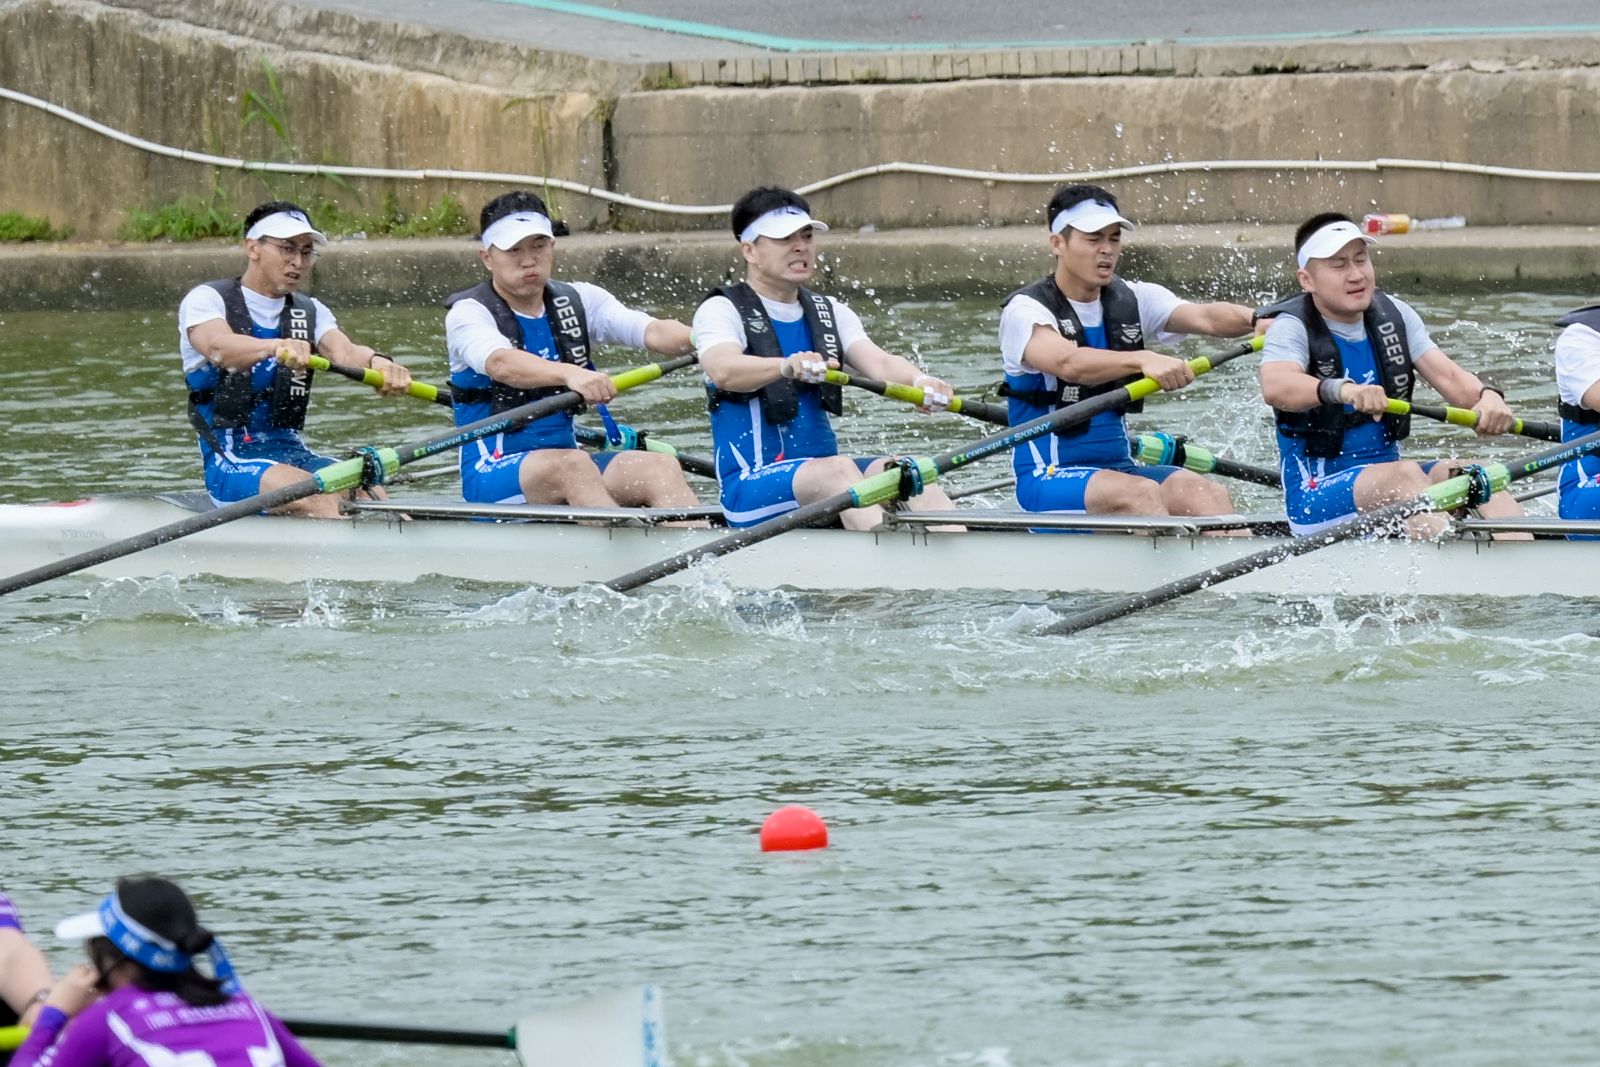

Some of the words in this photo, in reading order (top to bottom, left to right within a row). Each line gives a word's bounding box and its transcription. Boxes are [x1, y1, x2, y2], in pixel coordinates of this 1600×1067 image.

[290, 308, 308, 339] DEE
[553, 296, 582, 338] DEEP
[811, 295, 832, 328] DEEP
[1378, 321, 1406, 366] DEEP
[427, 435, 462, 453] concept
[473, 420, 508, 438] SKINNY
[966, 440, 1002, 459] concept
[1014, 421, 1051, 441] SKINNY
